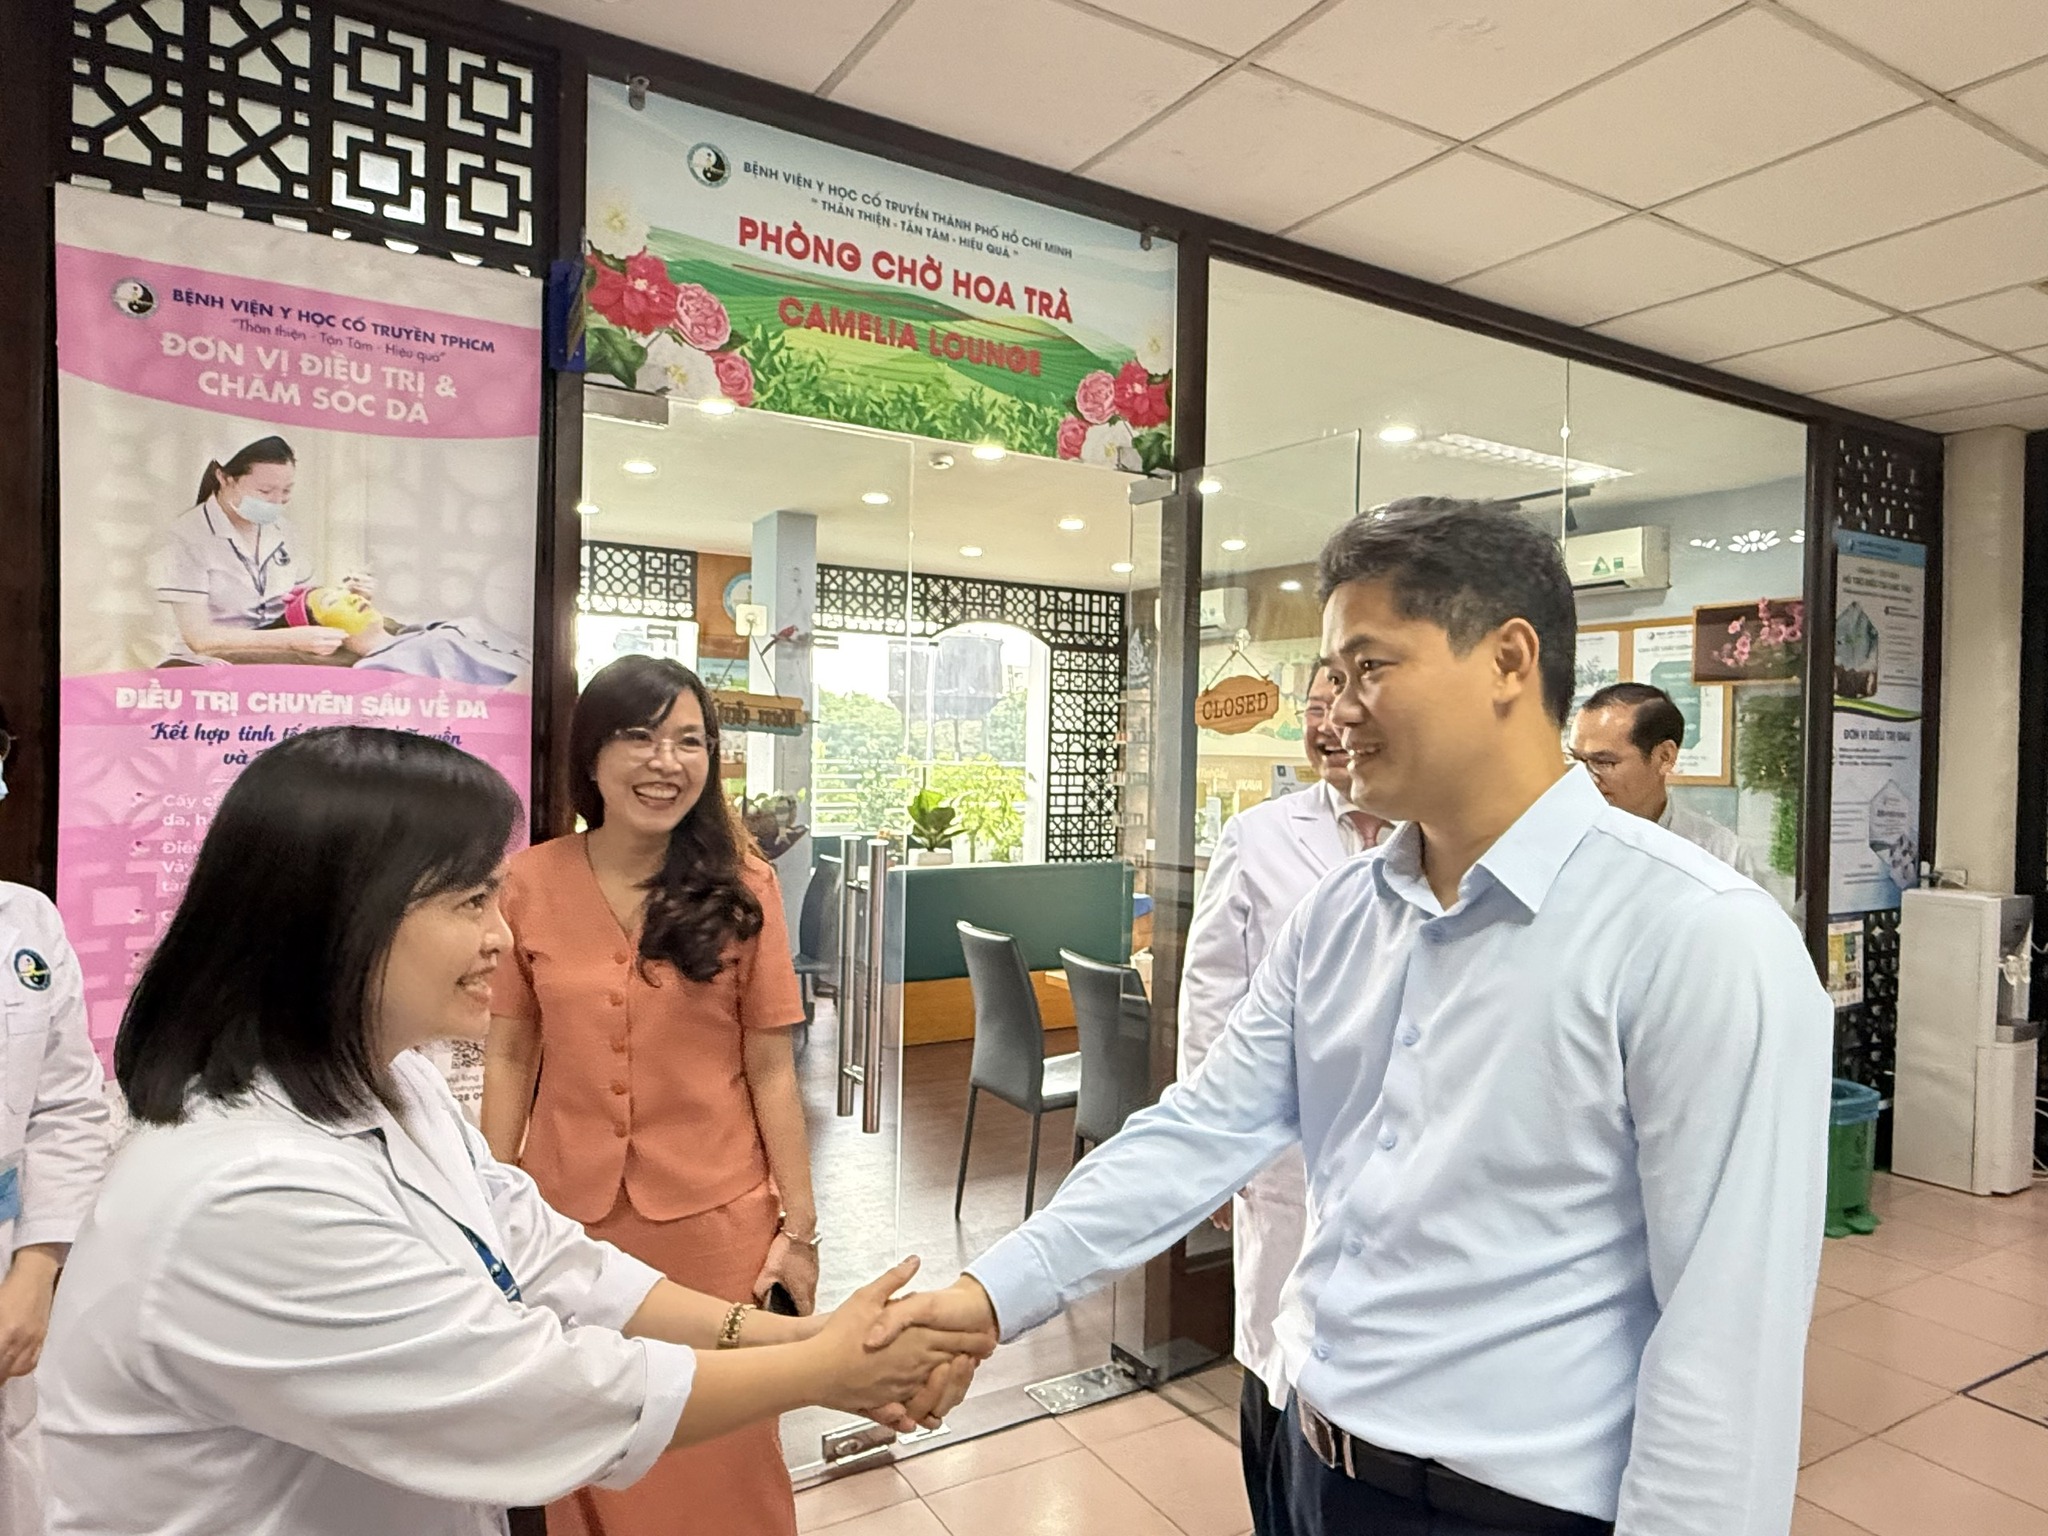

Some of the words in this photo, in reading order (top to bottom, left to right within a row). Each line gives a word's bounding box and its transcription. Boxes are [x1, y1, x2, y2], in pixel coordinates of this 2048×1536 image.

[743, 161, 779, 180] BỆNH
[783, 171, 812, 190] VIỆN
[816, 180, 824, 191] Y
[828, 184, 858, 201] HỌC
[974, 223, 999, 239] PHỐ
[1021, 236, 1042, 250] CHÍ
[1044, 242, 1072, 259] MINH
[857, 209, 891, 228] THIỆN
[959, 236, 983, 251] HIỆU
[738, 216, 861, 272] PHÒNG
[872, 250, 942, 291] CHỜ
[952, 269, 1016, 310] HOA
[1024, 286, 1073, 323] TRÀ
[172, 288, 224, 308] BỆNH
[231, 298, 274, 317] VIỆN
[280, 306, 292, 319] Y
[298, 309, 336, 328] HỌC
[371, 323, 436, 344] TRUYỀN
[440, 334, 495, 353] TPHCM
[778, 296, 919, 351] CAMELIA
[929, 327, 1042, 377] LOUNGE
[160, 331, 244, 366] ĐƠN
[256, 345, 289, 377] VỊ
[299, 349, 371, 384] ĐIỀU
[381, 366, 425, 398] TRỊ
[435, 374, 457, 398] &
[198, 370, 301, 406] CHĂM
[312, 384, 376, 416] SÓC
[386, 398, 429, 425] DA
[115, 678, 183, 710] ĐIỀU
[191, 689, 239, 717] TRỊ
[247, 690, 353, 715] CHUYÊN
[360, 693, 411, 717] SÂU
[418, 688, 449, 718] VỀ
[456, 699, 489, 719] DA
[1202, 692, 1269, 720] CLOSED
[150, 720, 189, 740] Kết
[194, 723, 230, 746] hợp
[238, 724, 276, 742] tinh
[223, 749, 249, 765] và
